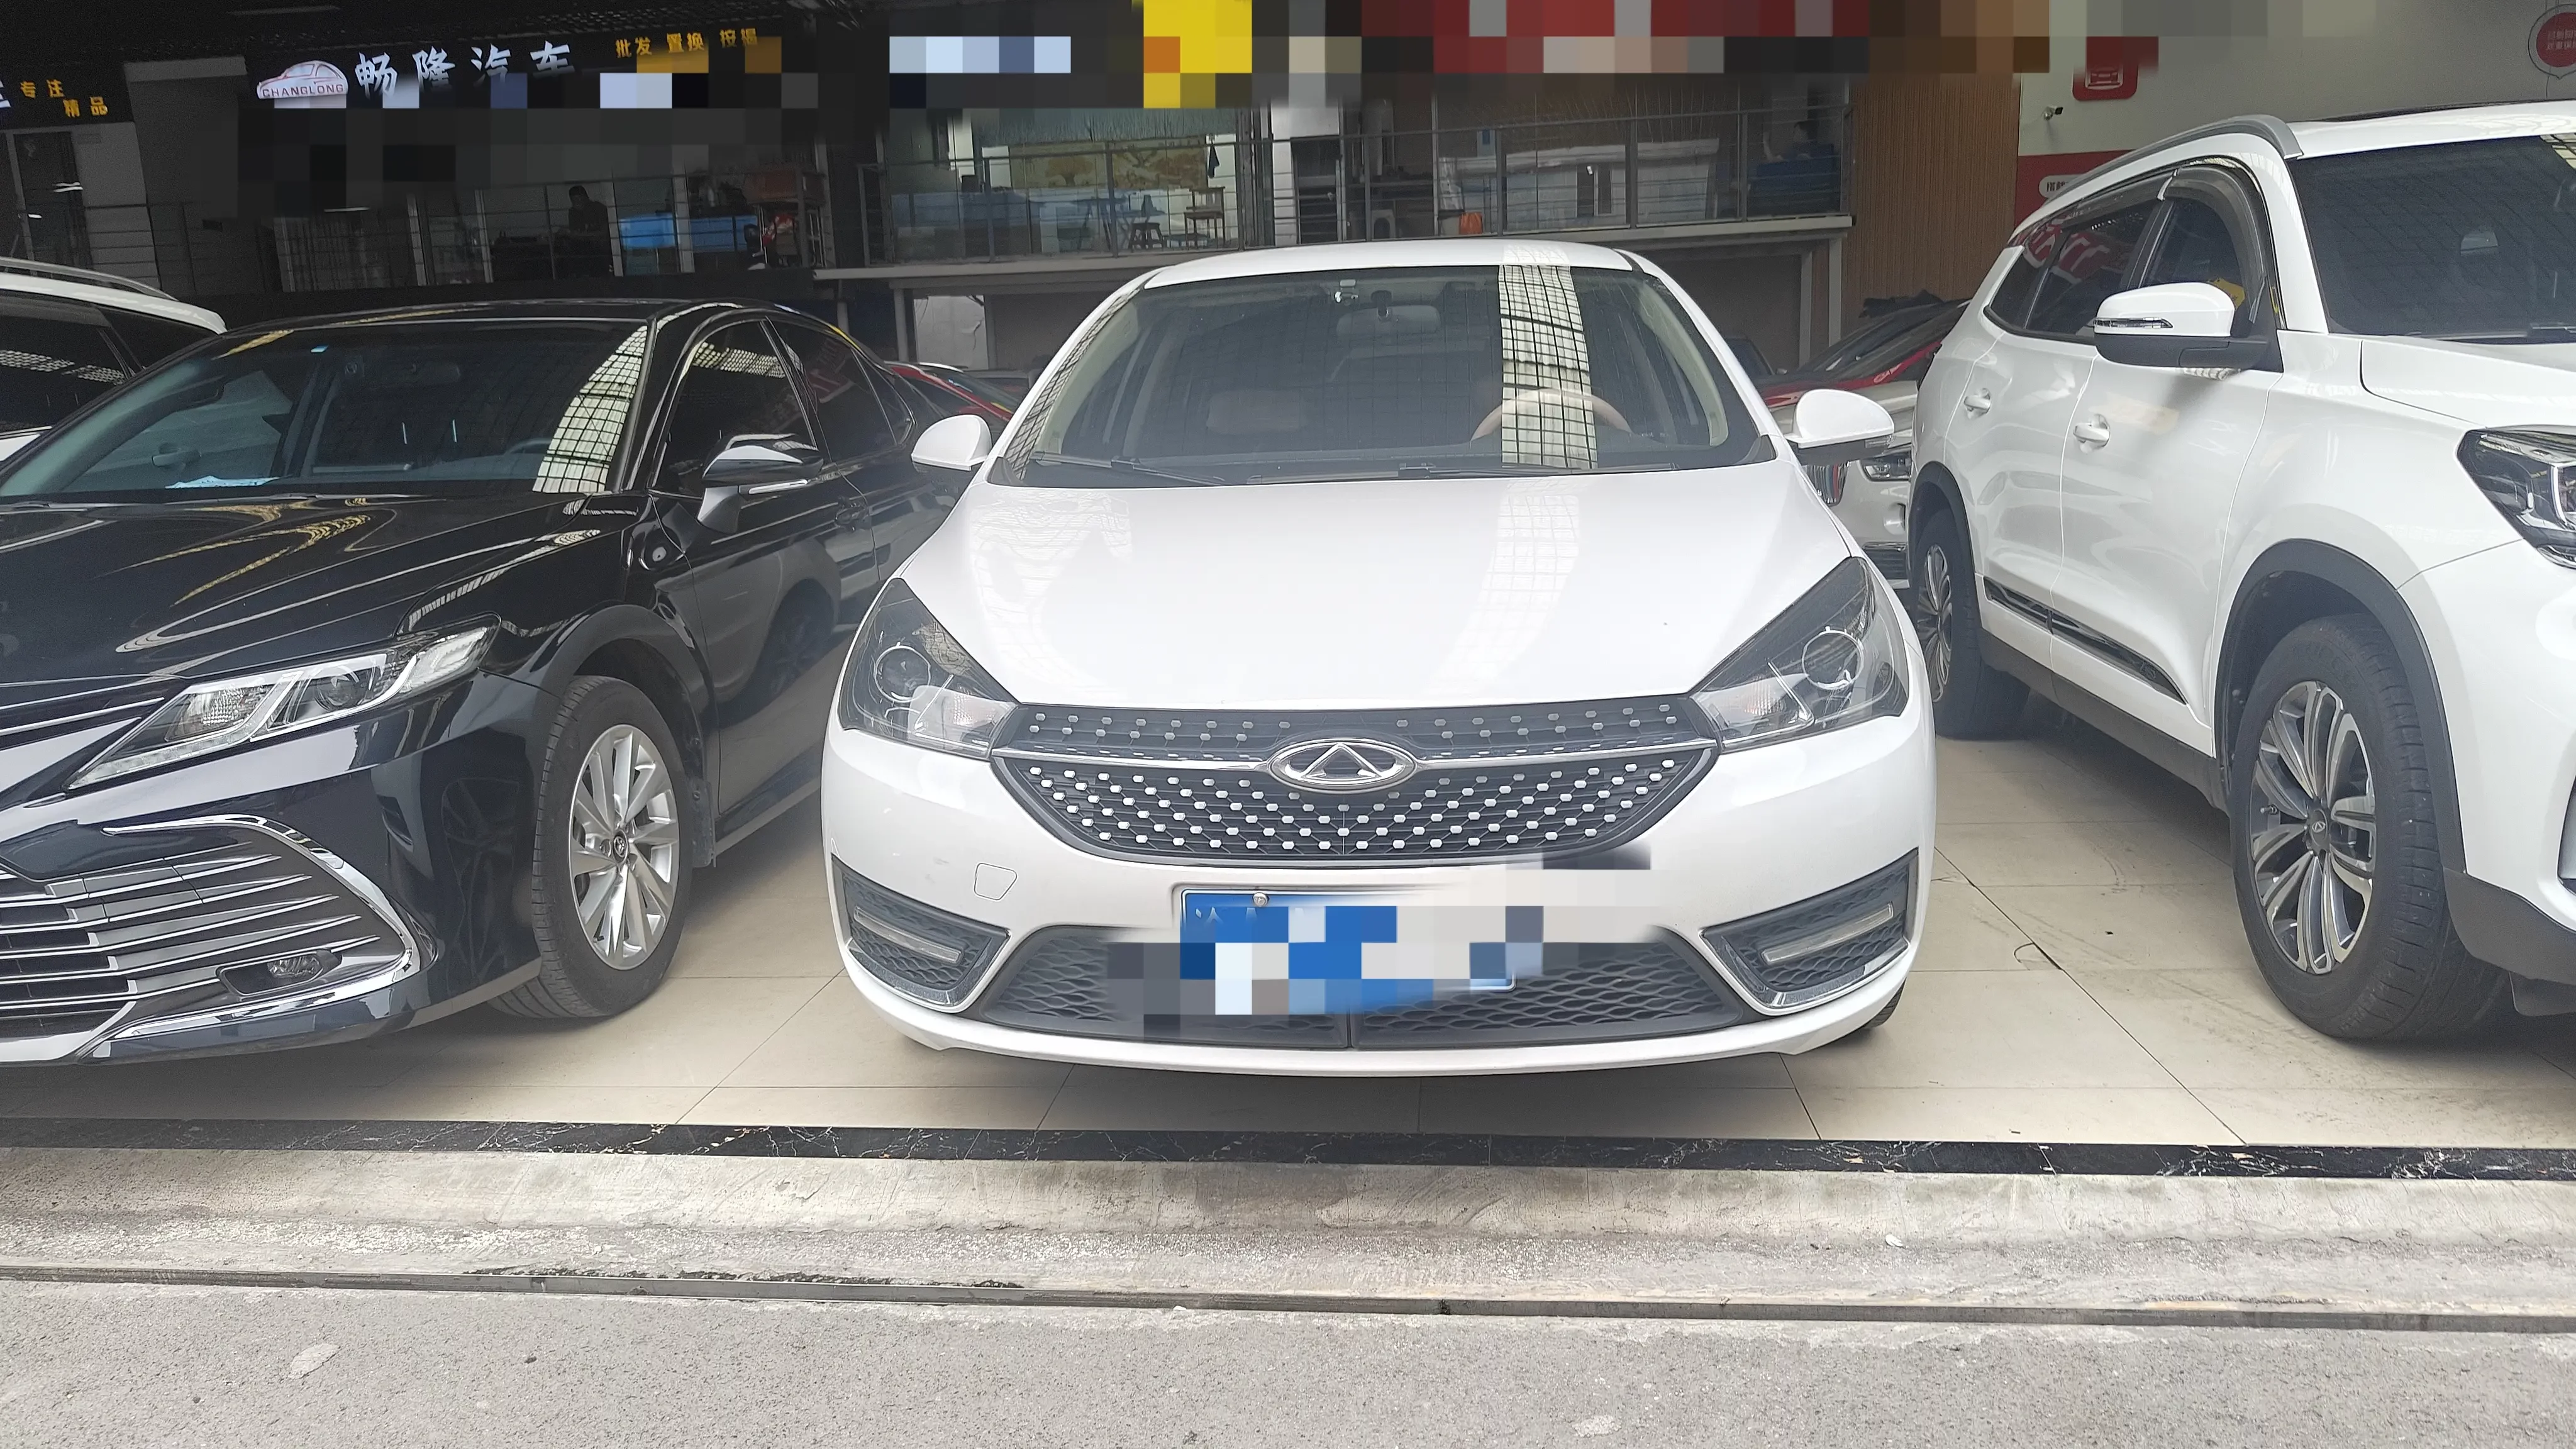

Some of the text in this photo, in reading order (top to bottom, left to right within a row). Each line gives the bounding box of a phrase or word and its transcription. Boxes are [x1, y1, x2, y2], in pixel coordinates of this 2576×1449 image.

[616, 36, 653, 58] 批发
[667, 32, 704, 53] 置换
[355, 40, 575, 99] 畅隆汽车
[262, 84, 344, 98] CHANGLONG
[63, 96, 108, 118] 精品
